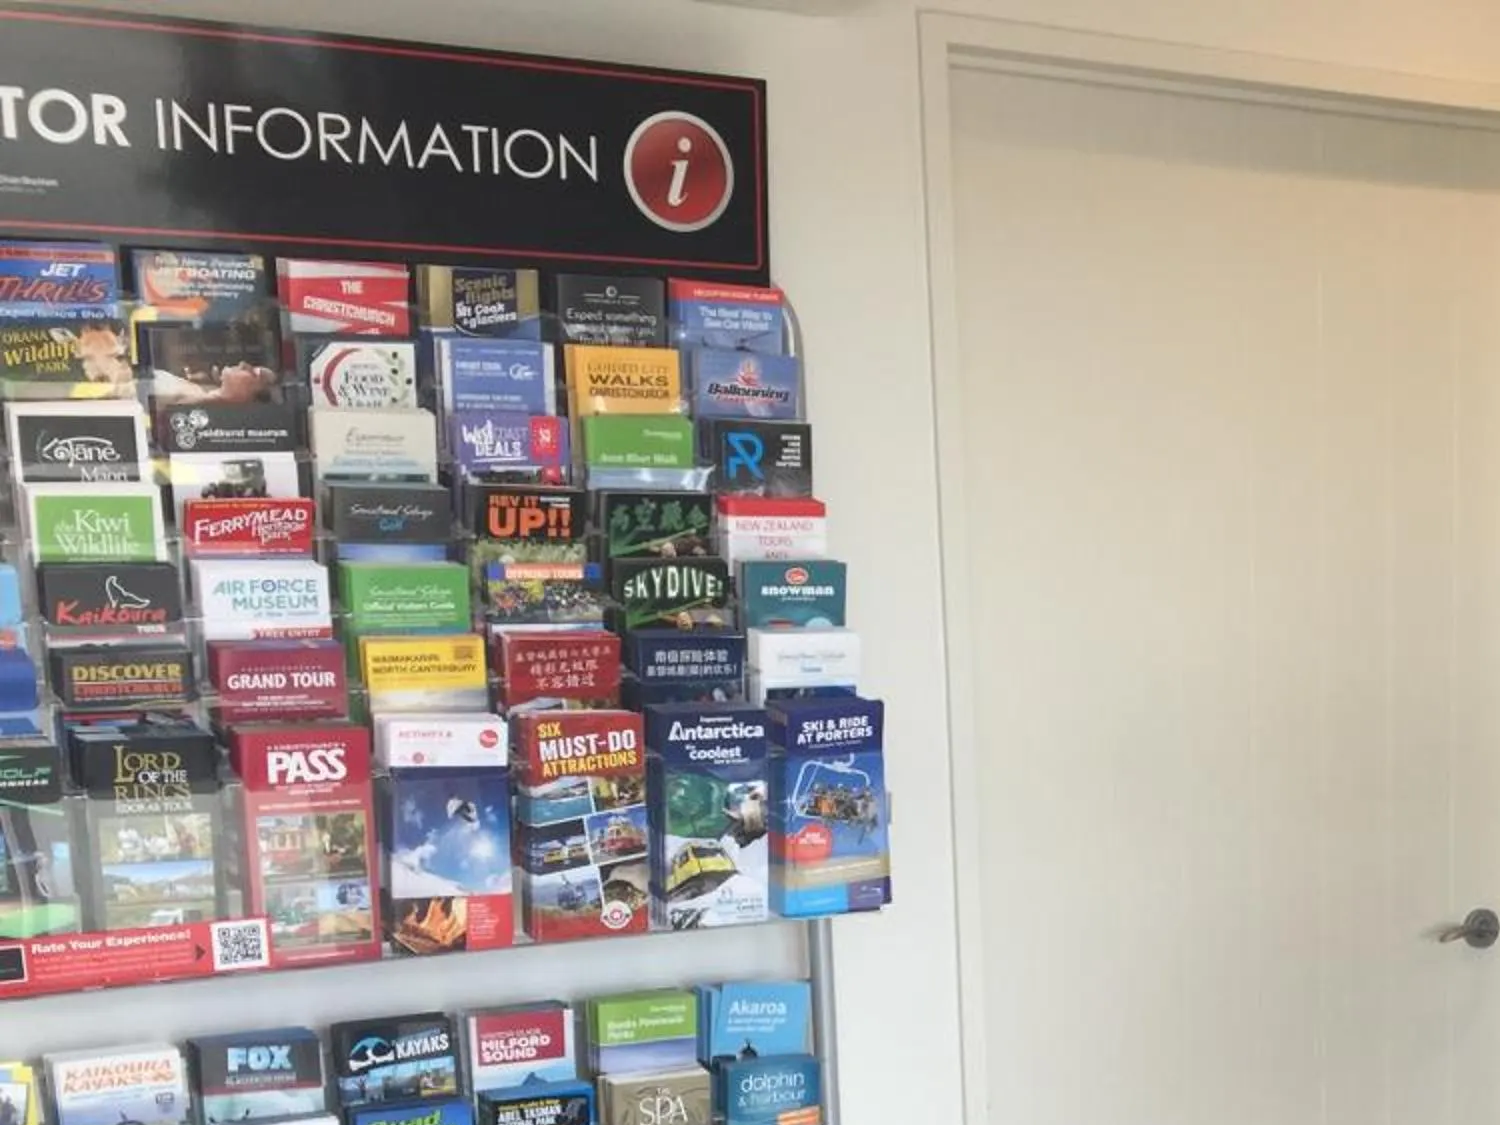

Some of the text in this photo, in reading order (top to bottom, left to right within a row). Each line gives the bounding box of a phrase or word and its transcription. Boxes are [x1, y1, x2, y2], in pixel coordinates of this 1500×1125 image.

[155, 98, 598, 182] INFORMATION
[41, 263, 87, 277] JET
[340, 281, 363, 294] THE
[455, 275, 507, 293] Scenic
[303, 296, 395, 327] CHRISTCHURCH
[2, 330, 48, 343] ORANA
[589, 374, 669, 387] WALKS
[589, 386, 670, 399] CHRISTCHURCH
[475, 442, 521, 456] DEALS
[74, 510, 133, 534] Kiwi
[195, 508, 307, 544] FERRYMEAD
[489, 508, 570, 538] UP!!
[736, 521, 813, 531] NEW ZEALAND
[214, 578, 316, 594] AIR FORCE
[624, 566, 723, 598] SKYDIVE!
[761, 585, 834, 596] snowman
[232, 596, 318, 610] MUSEUM
[72, 663, 182, 681] DISCOVER
[227, 672, 336, 689] GRAND TOUR
[537, 722, 561, 737] SIX
[668, 722, 764, 741] Antarctica
[803, 721, 825, 733] SKI
[841, 716, 869, 728] RIDE
[797, 733, 814, 745] AT
[816, 725, 873, 742] PORTERS
[539, 729, 636, 762] MUST-DO
[690, 744, 741, 761] coolest
[113, 746, 181, 783] LORD
[266, 749, 347, 784] PASS
[542, 751, 637, 777] ATTRACTIONS
[138, 770, 187, 784] OF THE
[113, 783, 192, 801] RINGS
[32, 930, 191, 955] Rate Your Experience!
[729, 1001, 786, 1016] Akaroa
[395, 1033, 448, 1059] KAYAKS
[481, 1035, 550, 1051] MILFORD
[227, 1046, 292, 1071] FOX
[482, 1048, 536, 1063] SOUND
[65, 1059, 171, 1081] KAIKOURA
[741, 1073, 804, 1093] dolphin
